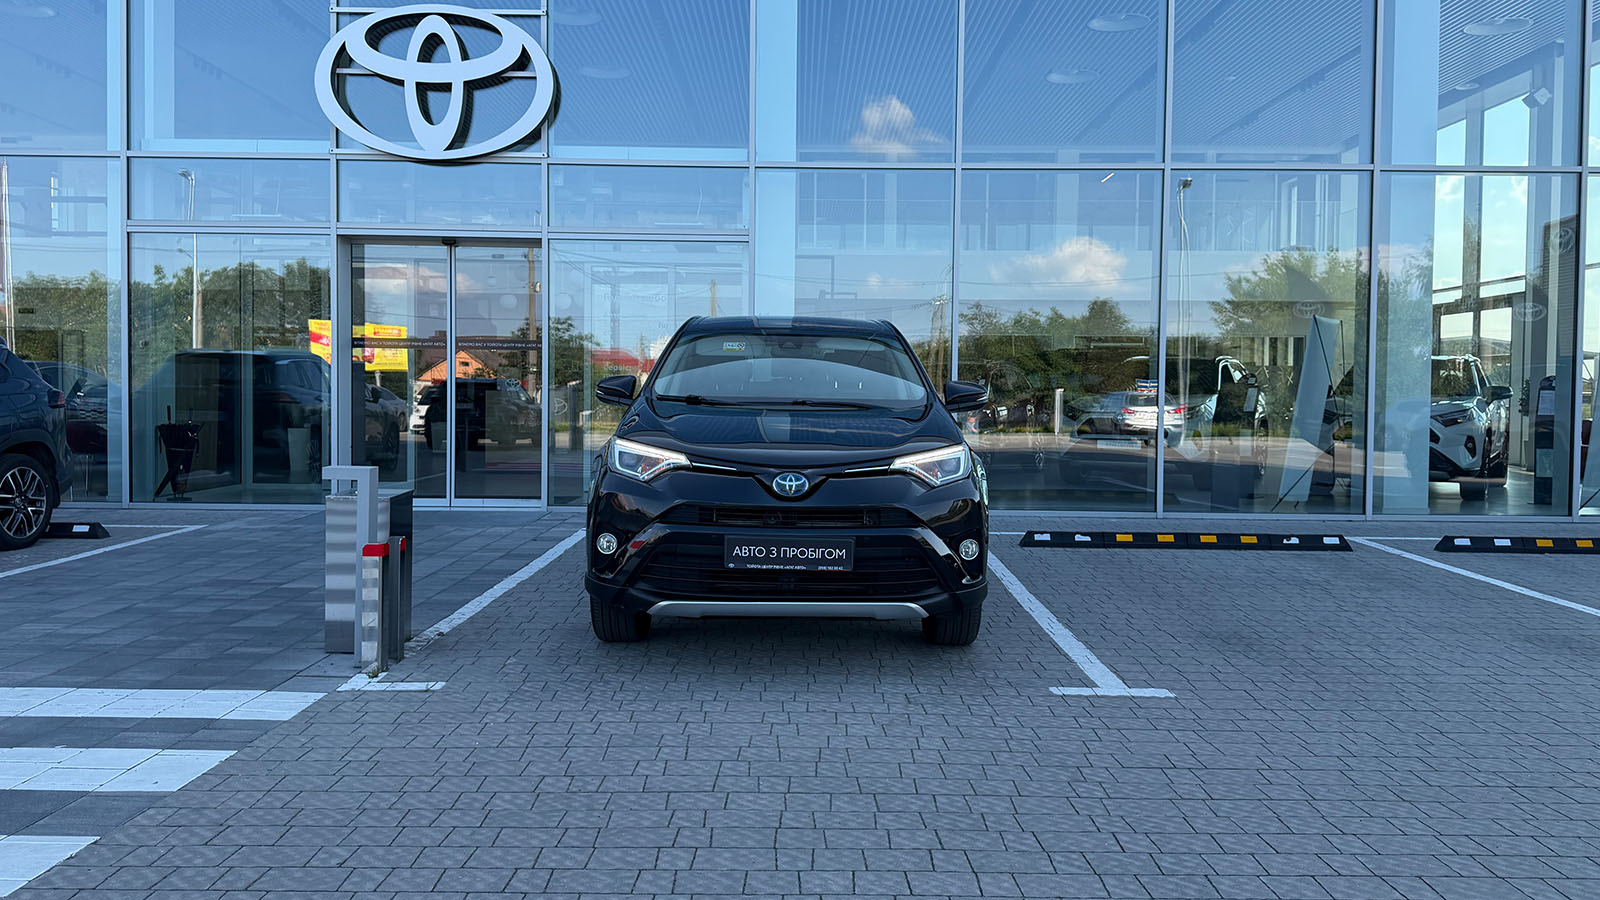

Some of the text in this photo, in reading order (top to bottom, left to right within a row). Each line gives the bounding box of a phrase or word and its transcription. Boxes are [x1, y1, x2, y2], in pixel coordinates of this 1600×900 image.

[732, 545, 846, 559] АВТО З ПРОБІГОМ
